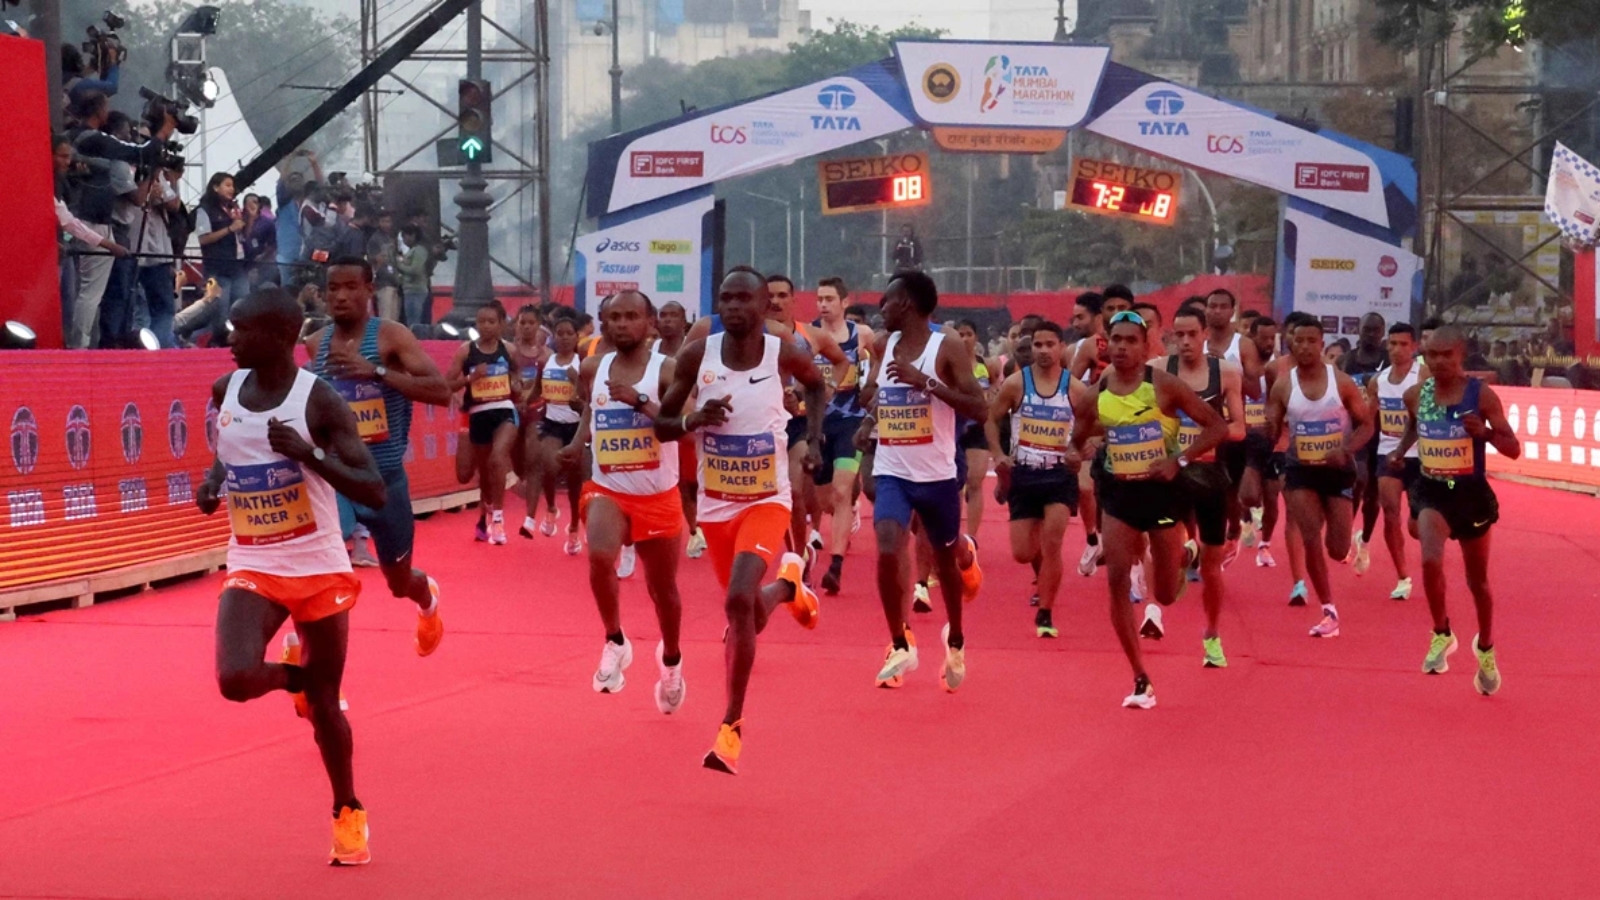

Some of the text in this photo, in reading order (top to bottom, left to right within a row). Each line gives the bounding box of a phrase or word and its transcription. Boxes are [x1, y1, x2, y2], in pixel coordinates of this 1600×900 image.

[1014, 66, 1049, 76] TATA
[1013, 77, 1058, 88] MUMBAI
[1013, 89, 1075, 101] MARATHON
[811, 115, 862, 131] TATA
[1138, 122, 1190, 136] TATA
[676, 156, 700, 166] FIRST
[824, 153, 921, 182] SEIKO
[655, 166, 675, 174] Bank
[1077, 159, 1175, 191] SEIKO
[1341, 170, 1366, 180] FIRST
[892, 174, 922, 202] 08
[1320, 179, 1341, 187] Bank
[597, 261, 640, 274] FAST&UP
[1310, 259, 1355, 270] SEIKO
[475, 380, 507, 392] SIFAN
[879, 407, 929, 420] BASHEER
[888, 421, 917, 431] PACER
[1022, 422, 1065, 437] KUMAR
[600, 436, 653, 452] ASRAR
[1300, 439, 1340, 452] ZEWDU
[1112, 447, 1163, 462] SARVESH
[1422, 446, 1468, 458] LANGAT
[707, 458, 770, 473] KIBARUS
[720, 475, 757, 486] PACER
[233, 487, 299, 511] MATHEW
[247, 510, 289, 526] PACER
